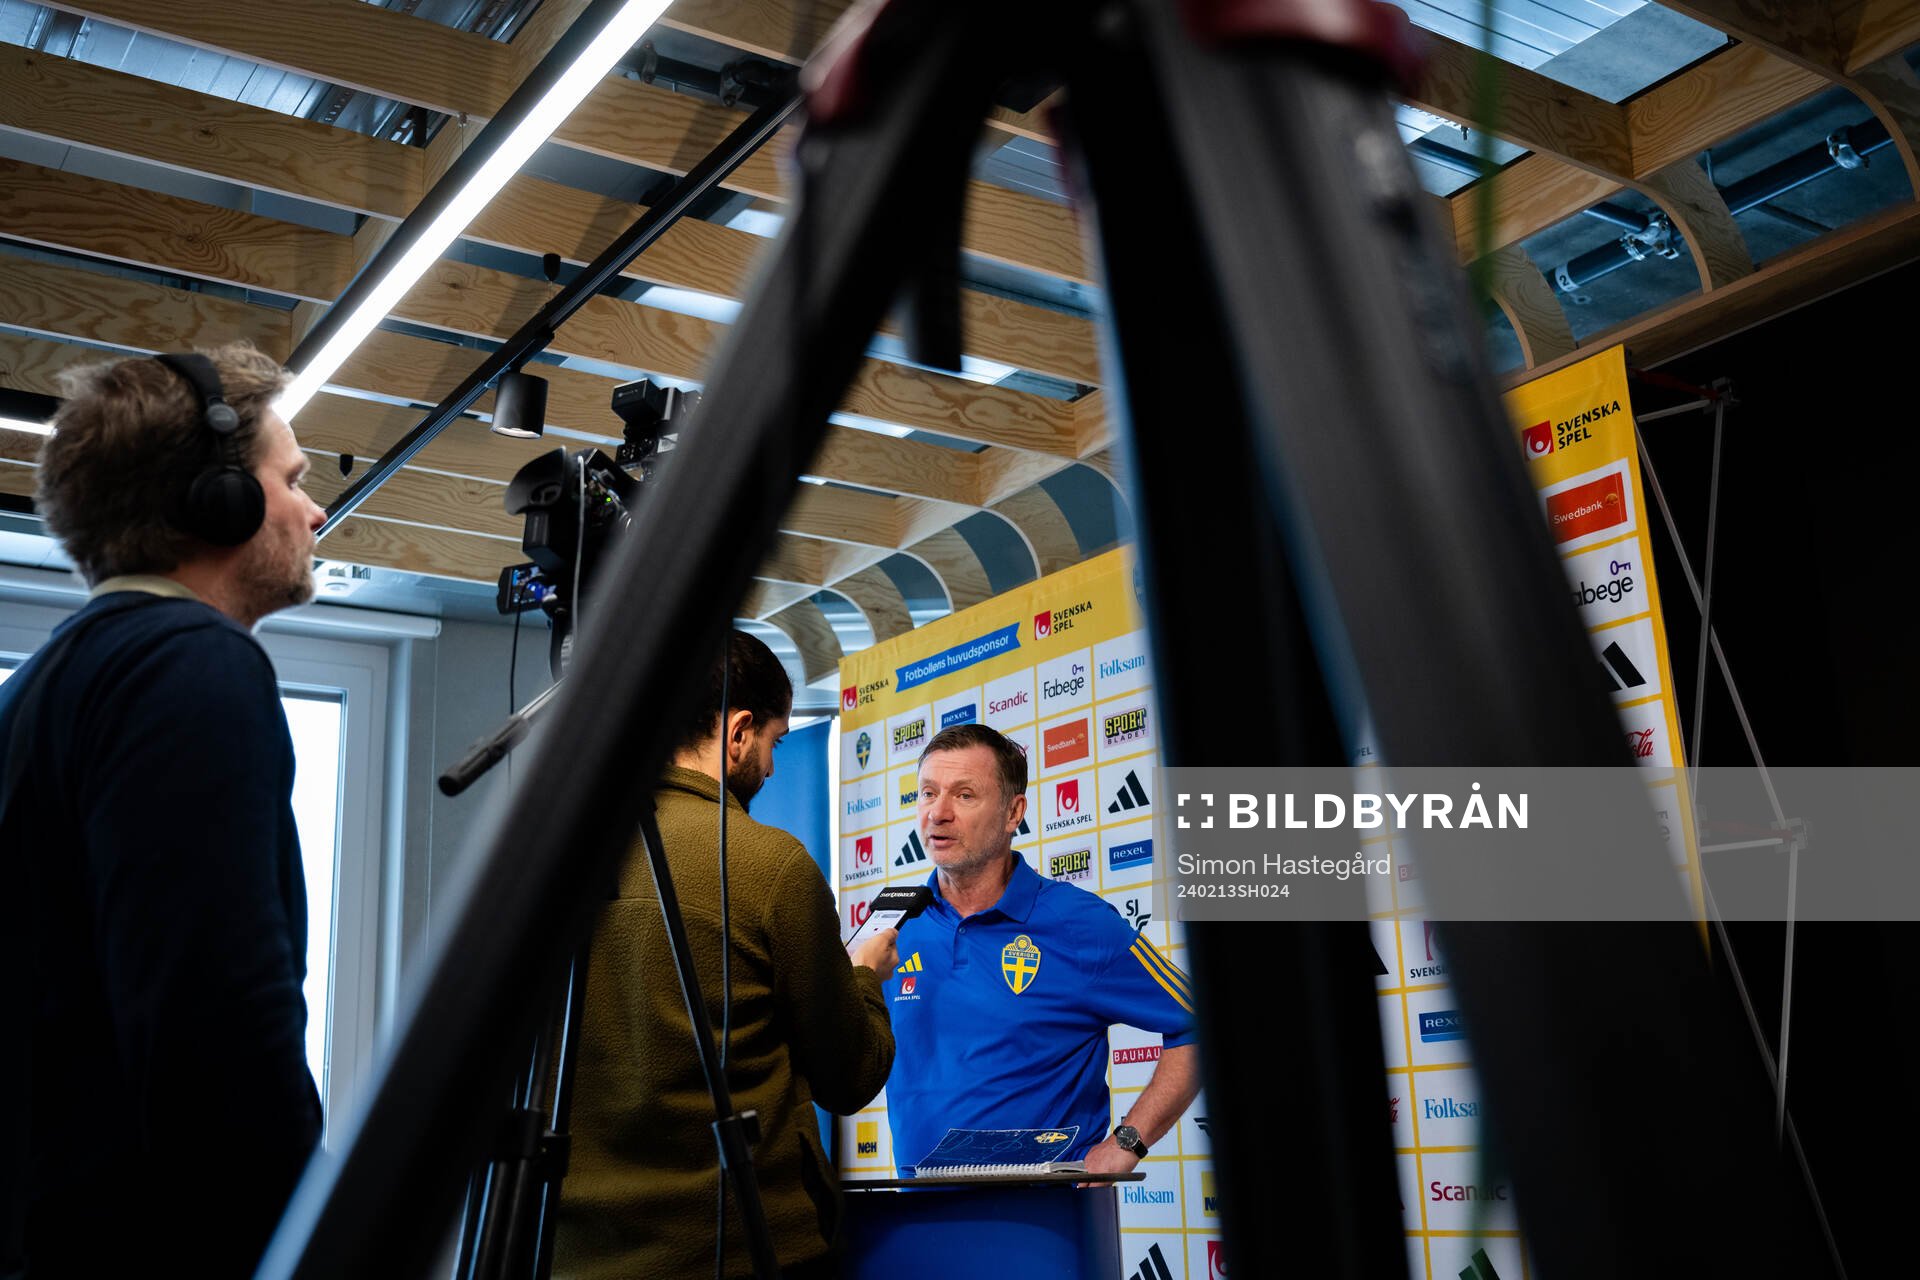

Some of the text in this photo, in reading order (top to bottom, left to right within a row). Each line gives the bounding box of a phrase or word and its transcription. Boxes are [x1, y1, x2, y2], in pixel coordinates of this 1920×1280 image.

[1557, 400, 1621, 436] SVENSKA
[1558, 427, 1592, 450] SPEL
[1554, 500, 1604, 525] Swedbank
[1571, 576, 1634, 608] abege
[1053, 601, 1093, 623] SVENSKA
[1054, 619, 1074, 634] SPEL
[905, 635, 1009, 682] Fotbollens huvudsponsor
[1100, 655, 1145, 679] Folksam
[859, 679, 889, 697] SVENSKA
[1043, 676, 1085, 699] Fabege
[859, 694, 875, 706] SPEL
[989, 690, 1028, 715] Scandic
[893, 719, 926, 745] SPORT
[1104, 708, 1147, 738] SPORT
[895, 737, 925, 751] BLADET
[1047, 739, 1077, 753] Swedbank
[1107, 730, 1146, 745] BLADET
[847, 797, 881, 815] Folksam
[1046, 814, 1093, 831] SVENSKA SPEL
[1050, 850, 1090, 876] SPORT
[845, 867, 883, 881] SVENSKA SPEL
[1126, 899, 1139, 917] SJ
[1410, 964, 1450, 979] SVENS
[1114, 1047, 1160, 1062] BAUHAU
[1424, 1097, 1481, 1120] Folksa
[1124, 1186, 1175, 1204] Folksam
